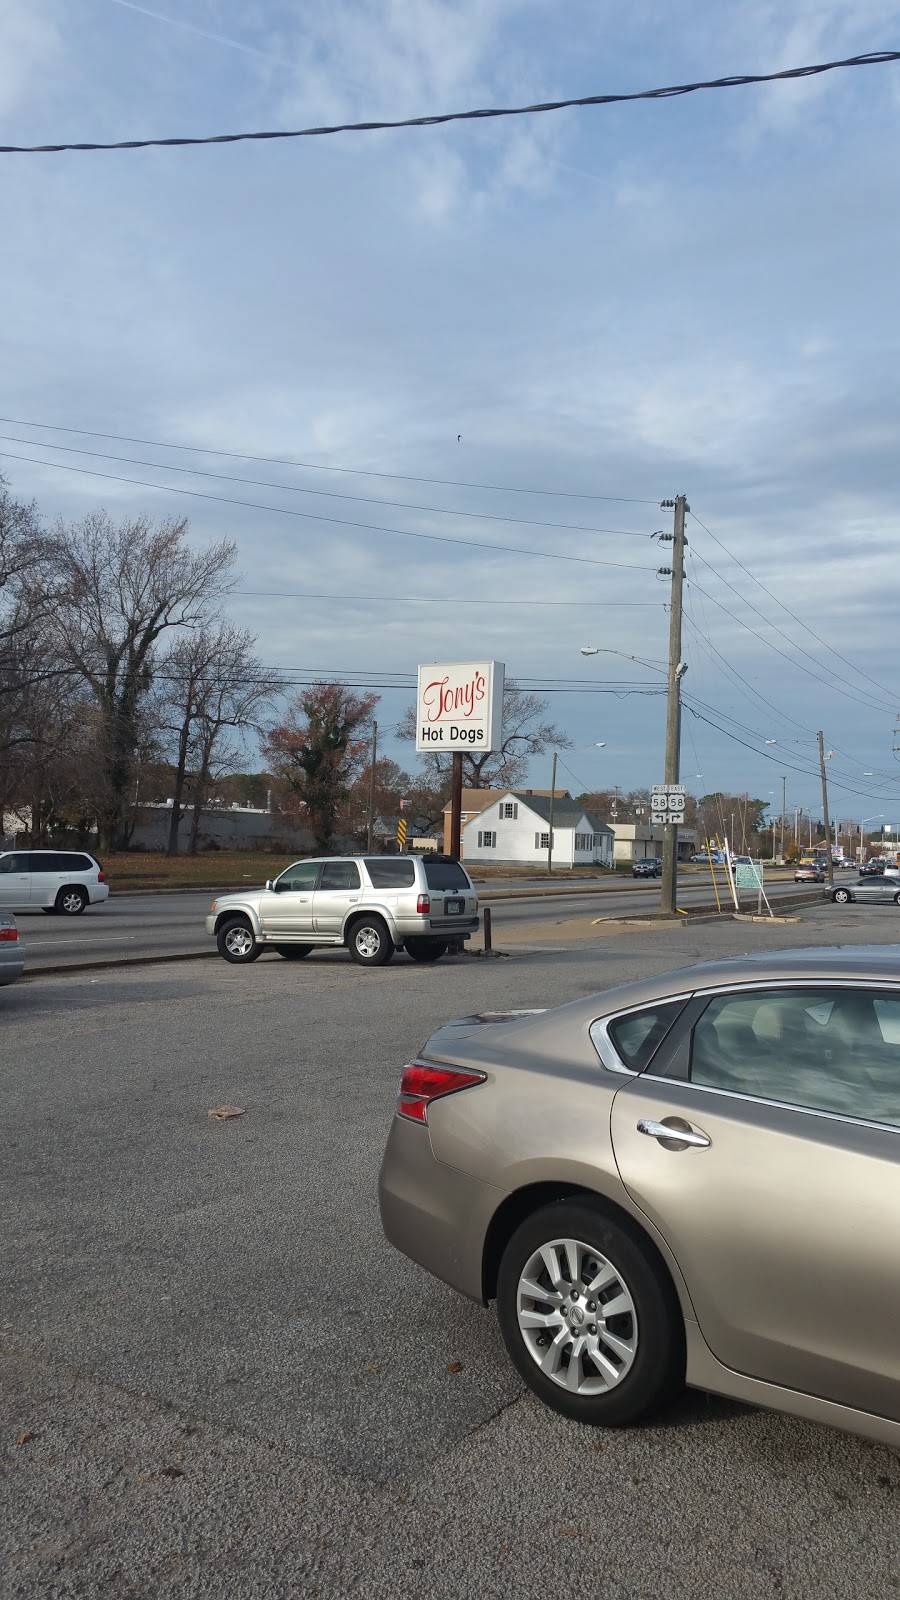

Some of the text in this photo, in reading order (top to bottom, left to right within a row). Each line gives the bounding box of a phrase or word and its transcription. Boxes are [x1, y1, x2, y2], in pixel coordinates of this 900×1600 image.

[423, 671, 485, 722] Tony's
[422, 726, 484, 743] Hot Dogs
[653, 798, 666, 807] 58
[670, 798, 683, 807] 58
